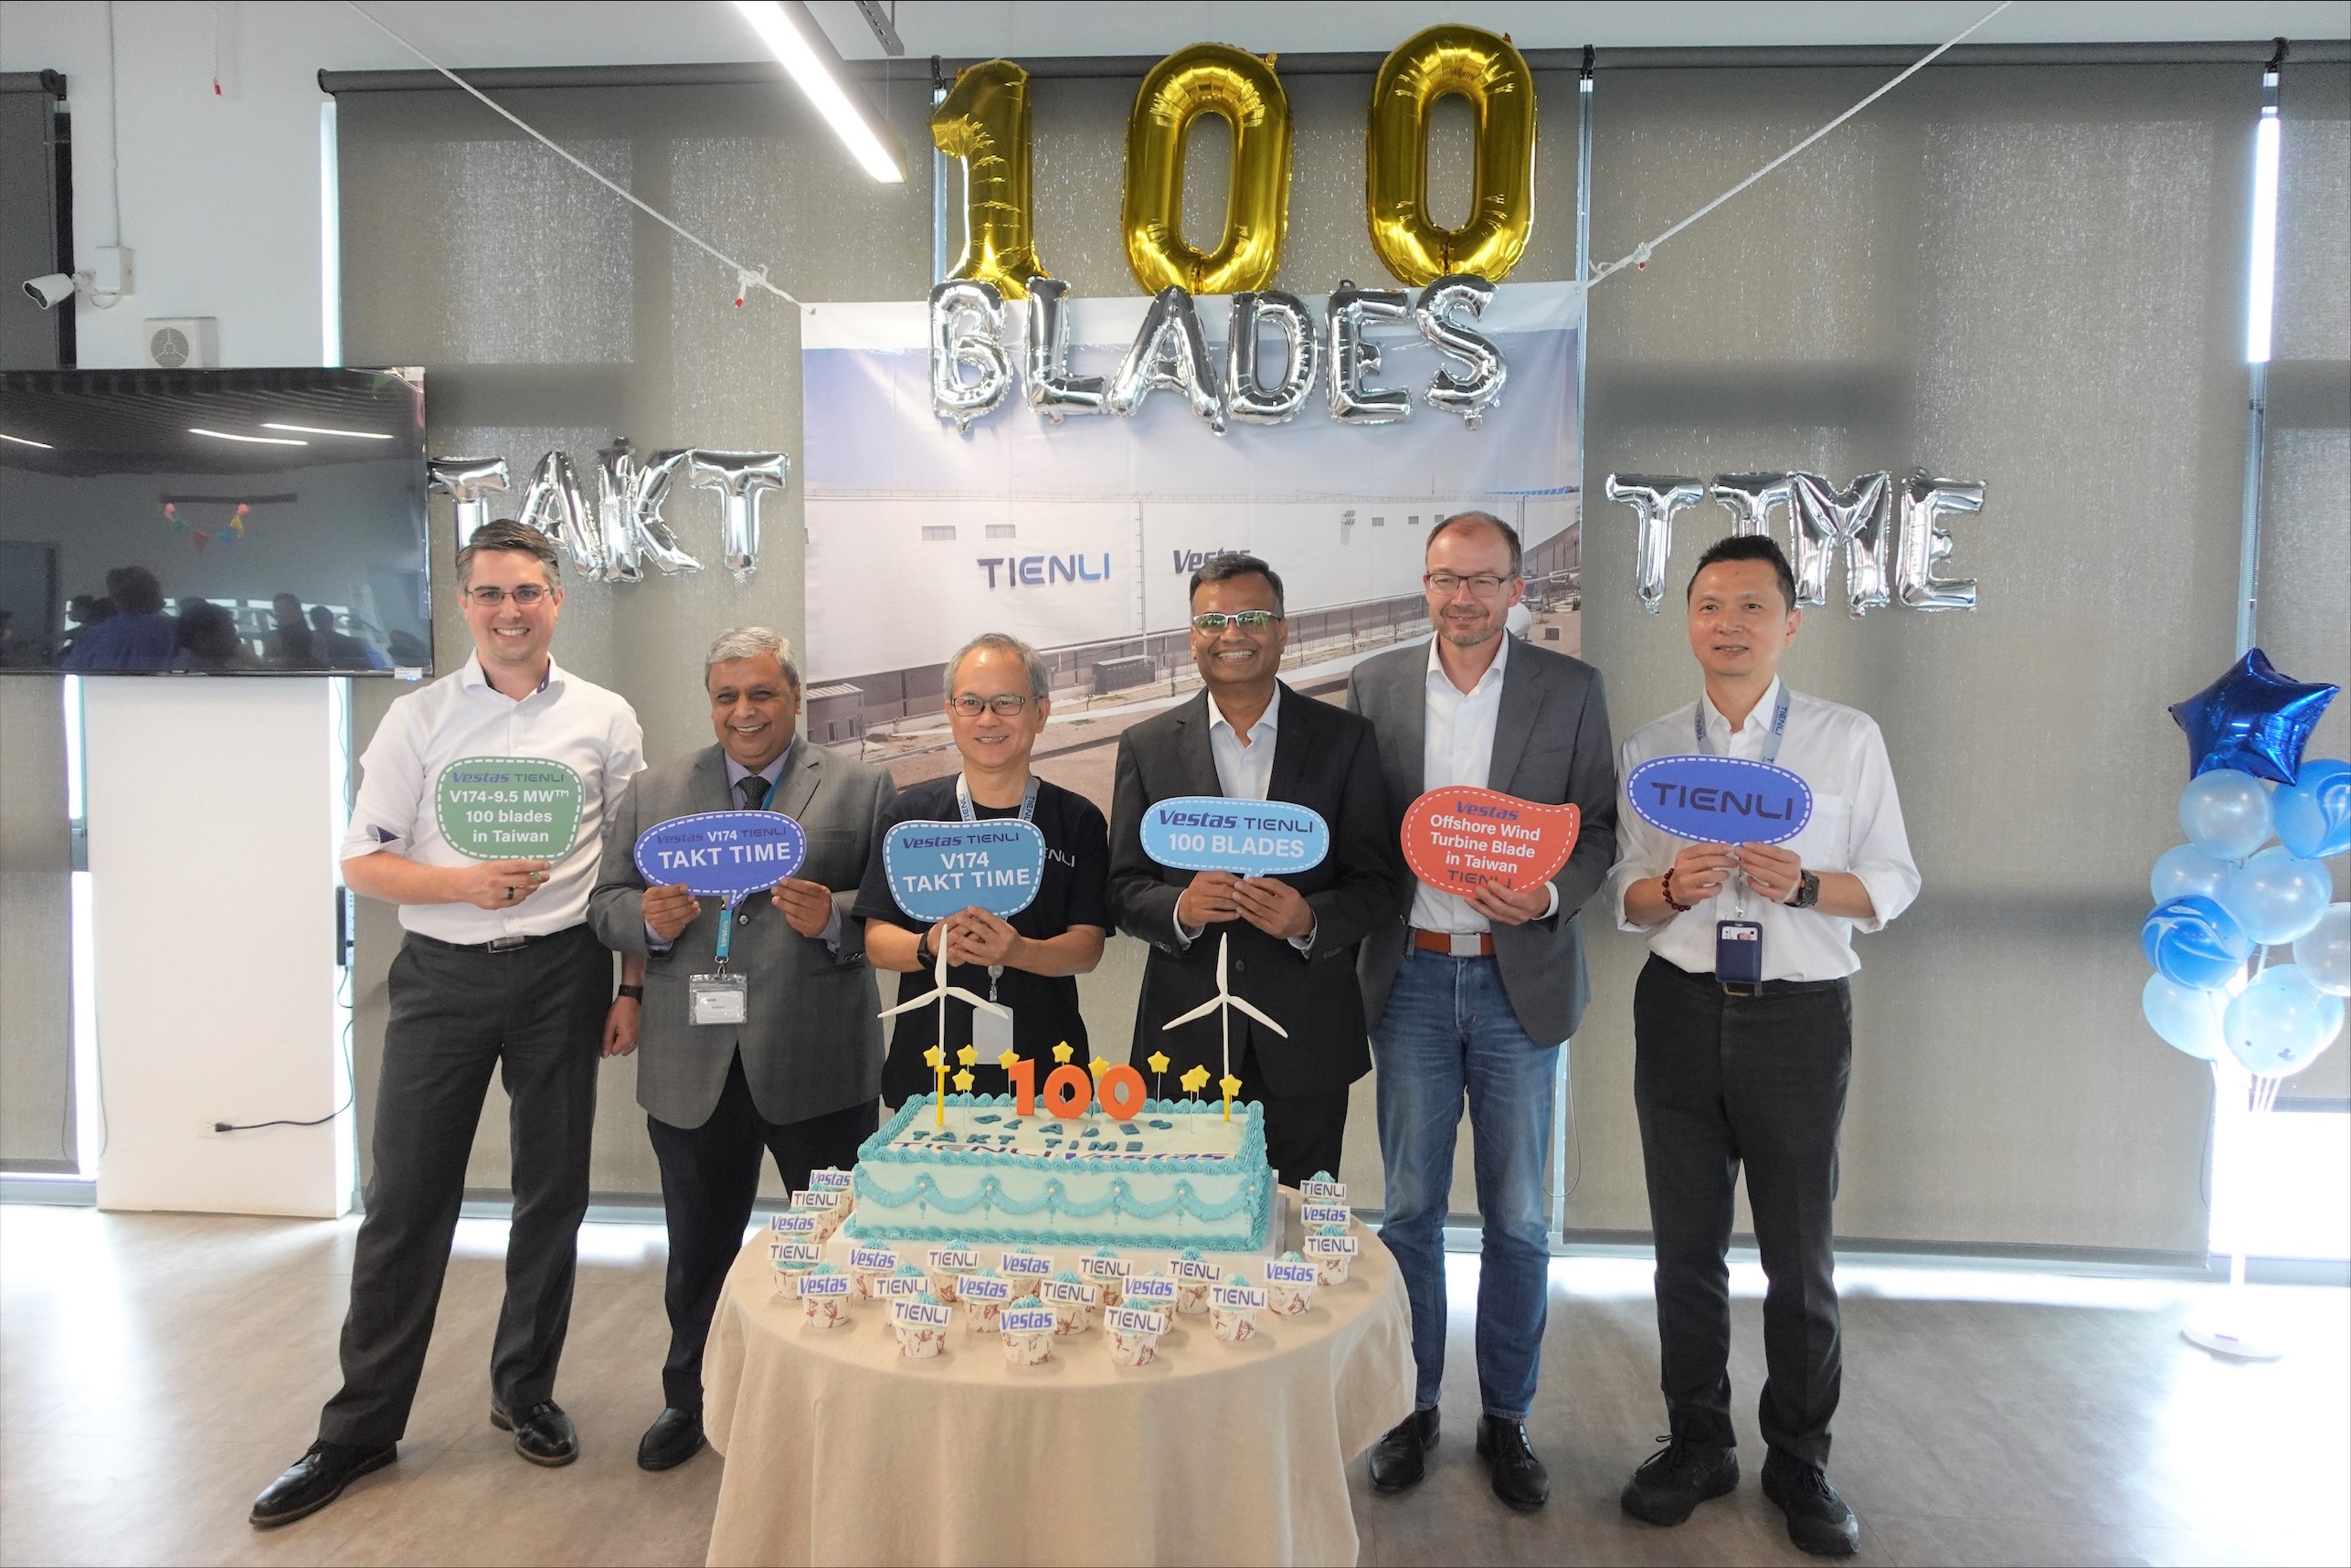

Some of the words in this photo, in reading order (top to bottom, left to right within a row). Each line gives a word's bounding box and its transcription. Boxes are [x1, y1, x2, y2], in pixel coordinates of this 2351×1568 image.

[929, 24, 1538, 300] 100
[927, 276, 1509, 437] BLADES
[428, 442, 789, 584] TAKT
[977, 553, 1109, 588] TIENLI
[1775, 705, 1788, 736] TIENLI
[452, 771, 510, 783] Vestas
[514, 773, 564, 782] TIENLI
[450, 789, 518, 803] V174-9.5
[1650, 782, 1794, 821] TIENLI
[466, 810, 493, 823] 100
[499, 810, 552, 823] blades
[1024, 796, 1035, 821] TIENL
[1456, 800, 1520, 821] Vestas
[1159, 810, 1238, 829] Vestas
[1244, 817, 1313, 833] TIENLI
[1429, 814, 1497, 835] Offshore
[1500, 823, 1541, 842] Wind
[472, 830, 488, 842] in
[492, 830, 549, 842] Taiwan
[656, 831, 704, 844] Vestas
[707, 830, 737, 842] V174
[741, 827, 787, 838] TIENLI
[903, 835, 962, 849] Vestas
[967, 832, 1019, 844] TIENLI
[1169, 833, 1206, 853] 100
[1212, 834, 1305, 858] BLADES
[1430, 832, 1488, 852] Turbine
[1491, 840, 1536, 859] Blade
[658, 847, 723, 869] TAKT
[729, 842, 791, 863] TIME
[940, 851, 990, 869] V174
[1445, 851, 1460, 865] in
[1465, 854, 1519, 874] Taiwan
[903, 873, 965, 893] TAKT
[971, 868, 1031, 888] TIME
[1447, 869, 1511, 889] TIENI
[1009, 1058, 1147, 1120] 100
[894, 1141, 1052, 1158] TIENLI
[913, 1130, 1015, 1145] TAKT
[1045, 1138, 1144, 1151] TIME
[811, 1171, 851, 1186] Vestas
[794, 1192, 838, 1206] TIENLI
[1302, 1181, 1345, 1198] TIENLI
[771, 1215, 815, 1231] Vestas
[1303, 1206, 1346, 1222] Vestas
[770, 1245, 819, 1260] TIENLI
[1308, 1238, 1355, 1254] TIENLI
[850, 1248, 896, 1269] Vestas
[929, 1251, 978, 1267] TIENLI
[1003, 1255, 1050, 1274] Vestas
[1081, 1258, 1130, 1276] TIENLI
[1170, 1260, 1220, 1281] TIENLI
[1266, 1262, 1314, 1282] Vestas
[800, 1277, 848, 1295] Vestas
[877, 1278, 928, 1295] TIENLI
[958, 1277, 1009, 1298] Vestas
[1043, 1282, 1096, 1303] TIENLI
[1126, 1277, 1173, 1297] Vestas
[1213, 1287, 1265, 1307] TIENLI
[895, 1302, 948, 1324] TIENLI
[1001, 1311, 1054, 1330] Vestas
[1107, 1308, 1161, 1332] TIENLI
